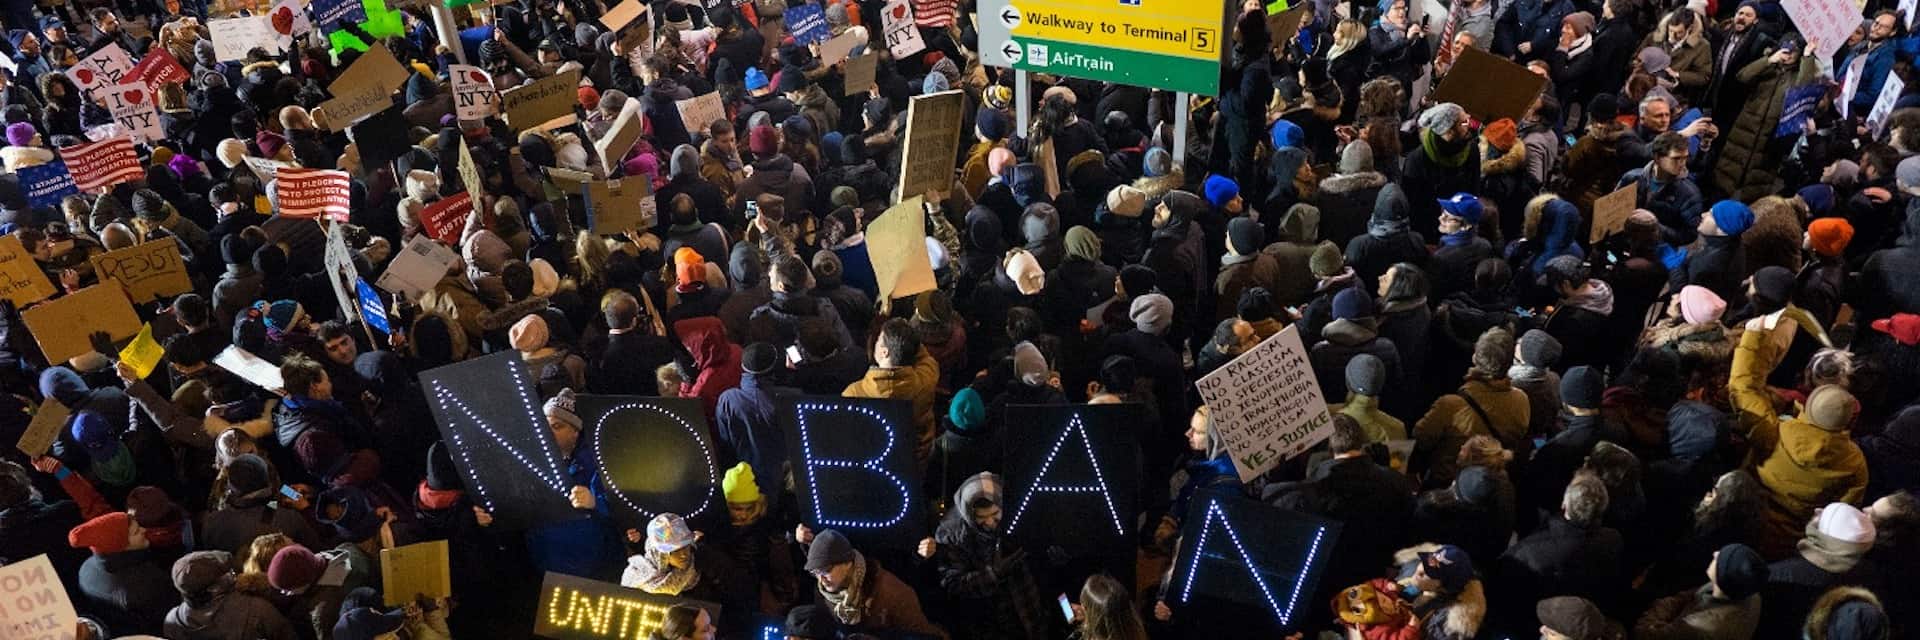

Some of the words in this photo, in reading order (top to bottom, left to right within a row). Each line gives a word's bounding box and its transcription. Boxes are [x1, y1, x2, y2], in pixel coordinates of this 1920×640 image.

[888, 23, 914, 47] NY
[1026, 12, 1094, 34] Walkway
[1100, 21, 1117, 35] to
[1123, 24, 1187, 44] Terminal
[1196, 32, 1208, 48] 5
[148, 64, 175, 95] USTICE!
[456, 70, 468, 85] I
[1052, 52, 1115, 72] AirTrain
[112, 92, 125, 109] I
[458, 91, 492, 107] NY
[117, 111, 153, 131] NY
[436, 212, 470, 241] JUSTIC
[101, 246, 179, 281] RESIST
[1200, 377, 1221, 395] NO
[1226, 340, 1283, 378] RACISM
[1206, 387, 1228, 403] NO
[1233, 348, 1294, 388] CLASSISM
[1212, 399, 1231, 413] NO
[1236, 355, 1305, 400] SPECIESISM
[1216, 410, 1235, 425] NO
[1237, 370, 1304, 413] XENOPHOBIA
[1220, 421, 1240, 436] NO
[1242, 380, 1313, 422] TRANSPHOBIA
[1226, 434, 1242, 446] NO
[1245, 392, 1317, 435] HOMOPHOBIA
[1233, 440, 1250, 453] NO
[1258, 408, 1306, 440] SEXISM
[1241, 444, 1278, 471] YES
[1278, 411, 1329, 449] JUSTICE
